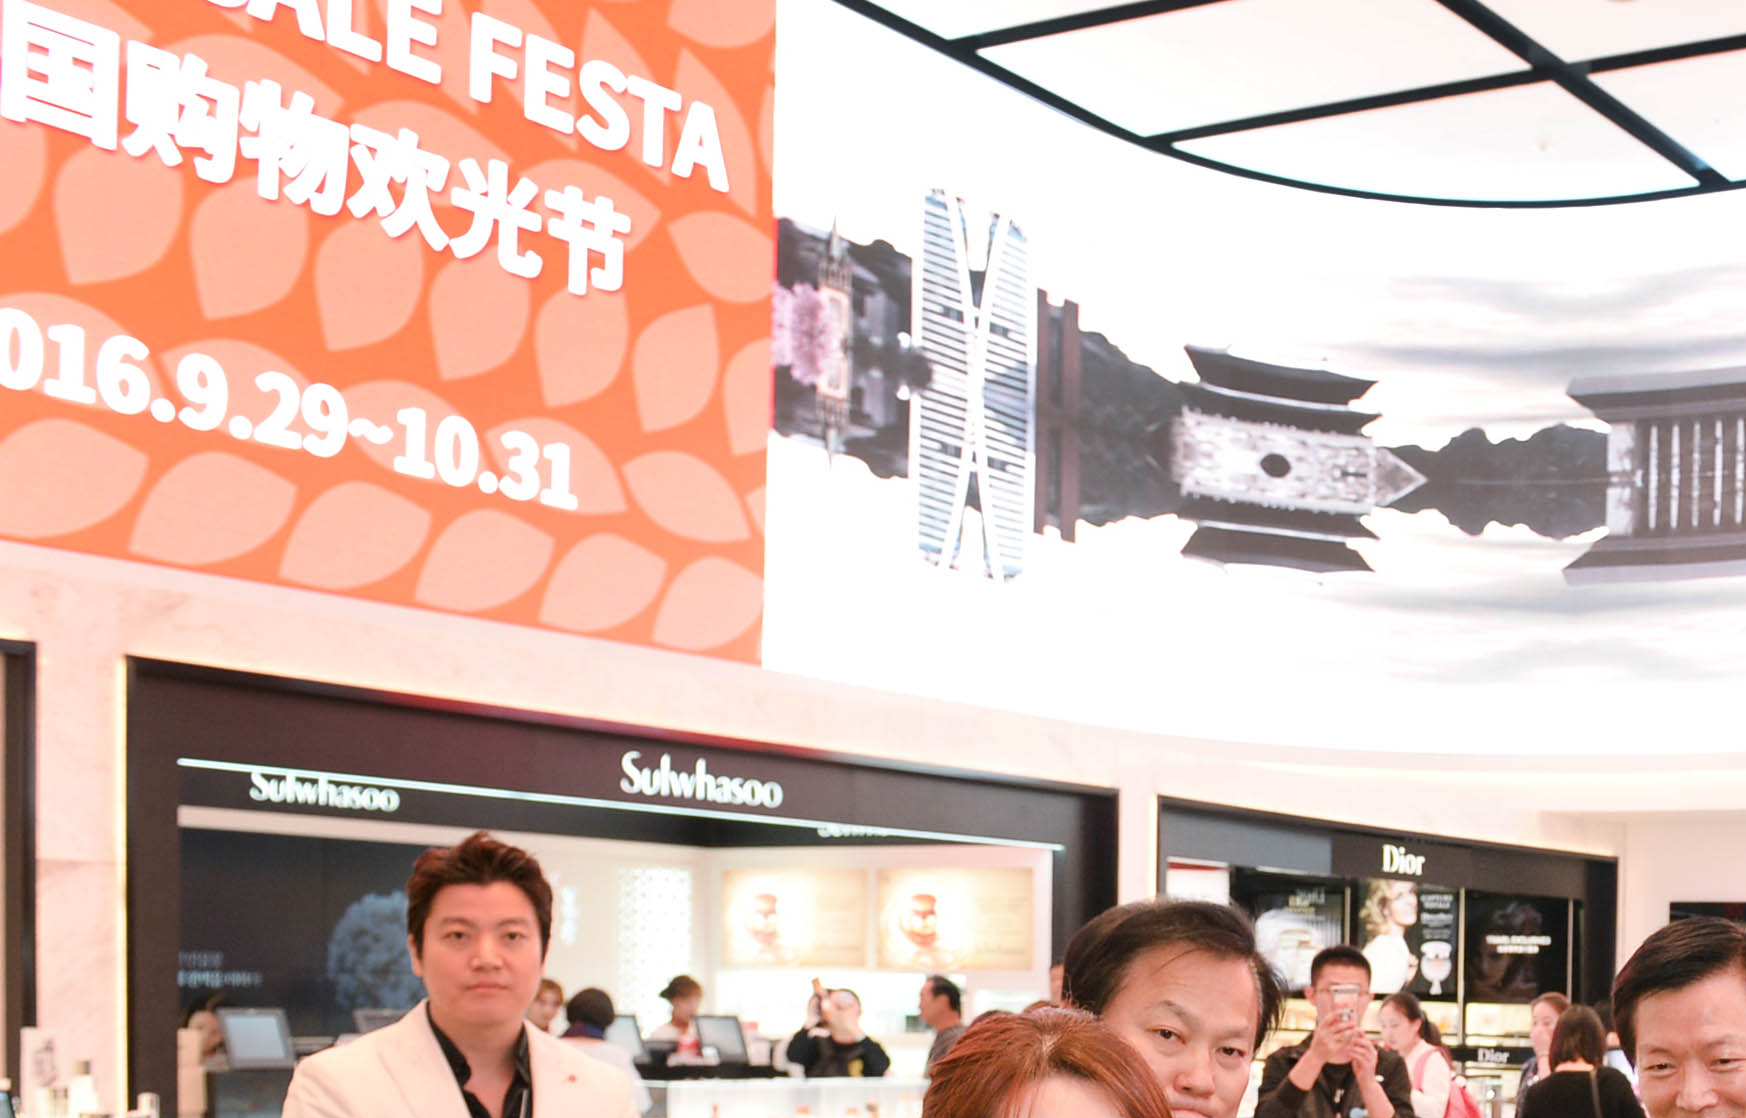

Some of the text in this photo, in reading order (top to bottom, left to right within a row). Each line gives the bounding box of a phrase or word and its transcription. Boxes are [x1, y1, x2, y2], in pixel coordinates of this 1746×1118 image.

[469, 12, 729, 193] FESTA
[0, 0, 631, 295] 国购物欢光节
[619, 750, 784, 809] Sulwhasoo
[1382, 844, 1426, 876] Dior
[1477, 1047, 1510, 1065] Dior
